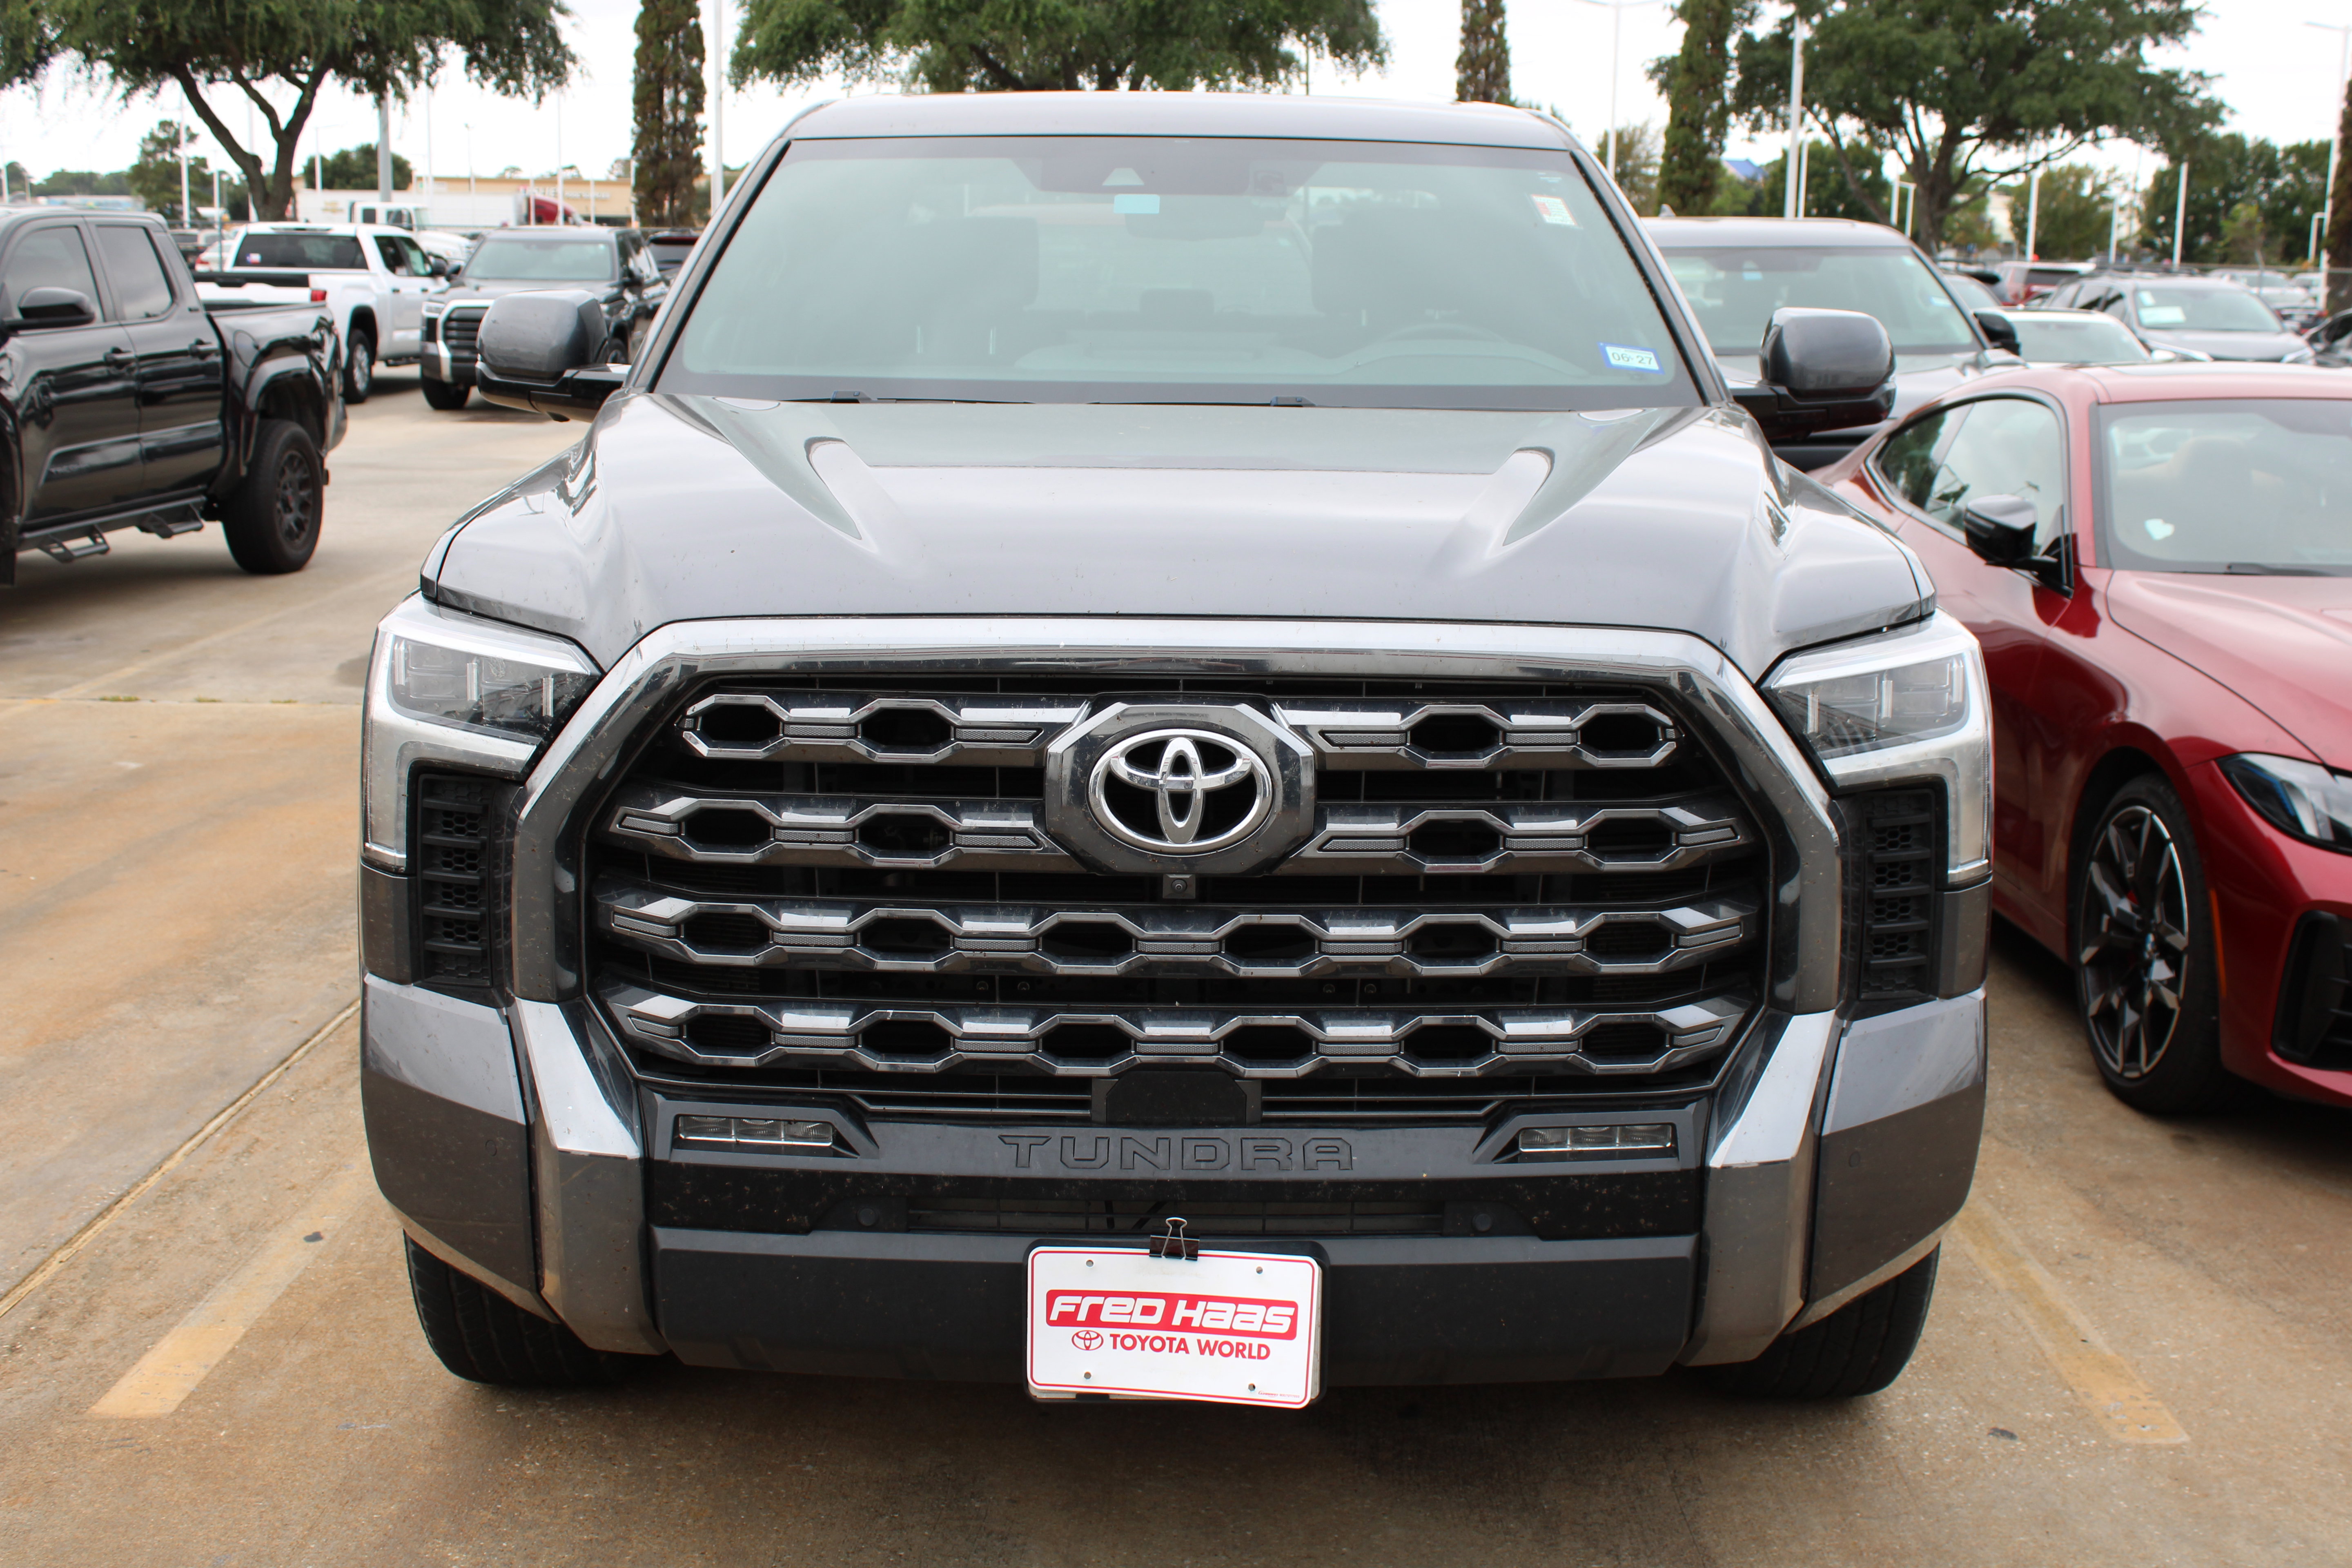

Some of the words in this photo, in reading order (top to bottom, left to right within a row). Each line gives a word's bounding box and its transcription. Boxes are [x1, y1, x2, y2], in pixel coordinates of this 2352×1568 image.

[998, 1134, 1353, 1171] TUNDRA
[1110, 1334, 1189, 1354] TOYOTA
[1197, 1339, 1270, 1360] WORLD
